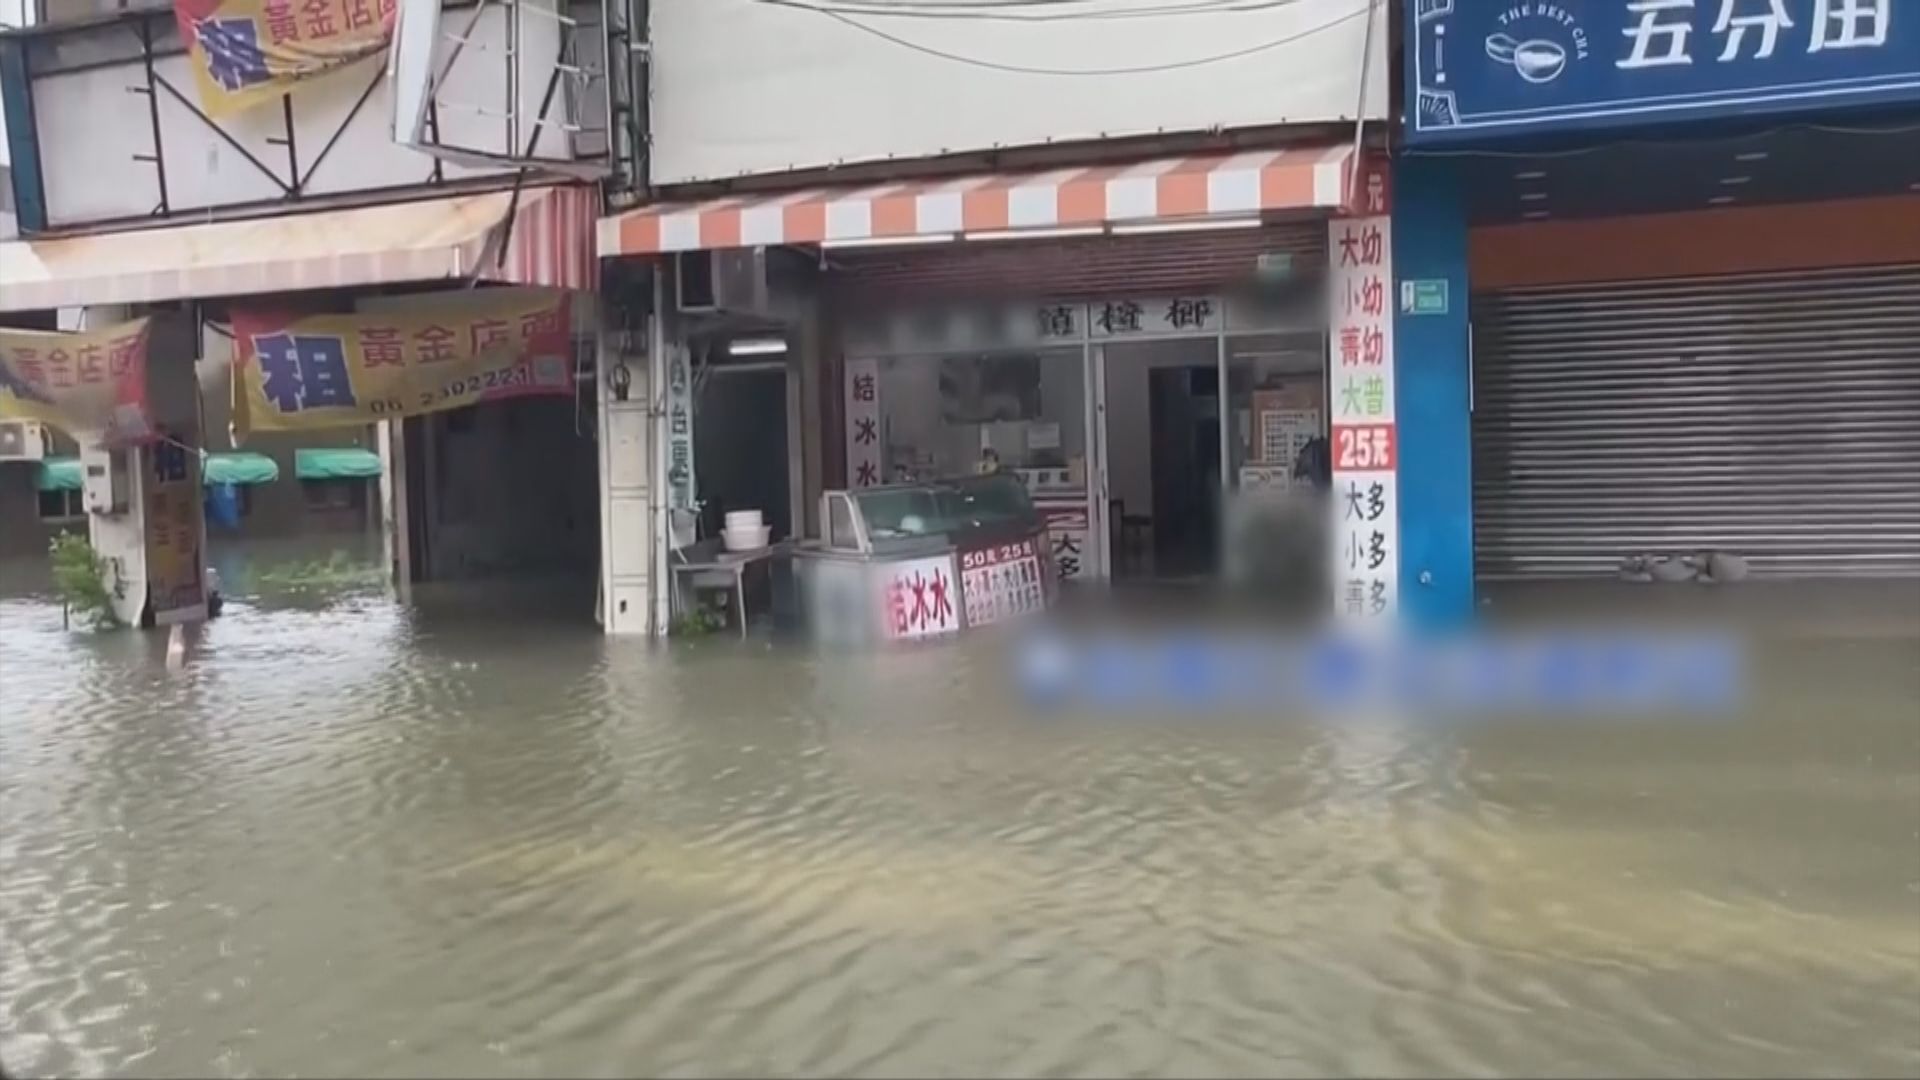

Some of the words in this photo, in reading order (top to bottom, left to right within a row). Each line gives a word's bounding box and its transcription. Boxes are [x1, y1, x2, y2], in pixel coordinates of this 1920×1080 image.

[1498, 4, 1530, 25] THE
[1537, 3, 1574, 26] BEST
[1572, 27, 1589, 60] CHA
[1339, 224, 1382, 267] 大幼
[1340, 275, 1383, 317] 小幼
[1340, 325, 1384, 366] 菁幼
[252, 332, 357, 413] 租
[1341, 375, 1384, 415] 大普
[853, 372, 877, 487] 結冰水
[1339, 428, 1390, 467] 25元
[1345, 481, 1386, 521] 大多
[1345, 529, 1386, 569] 小多
